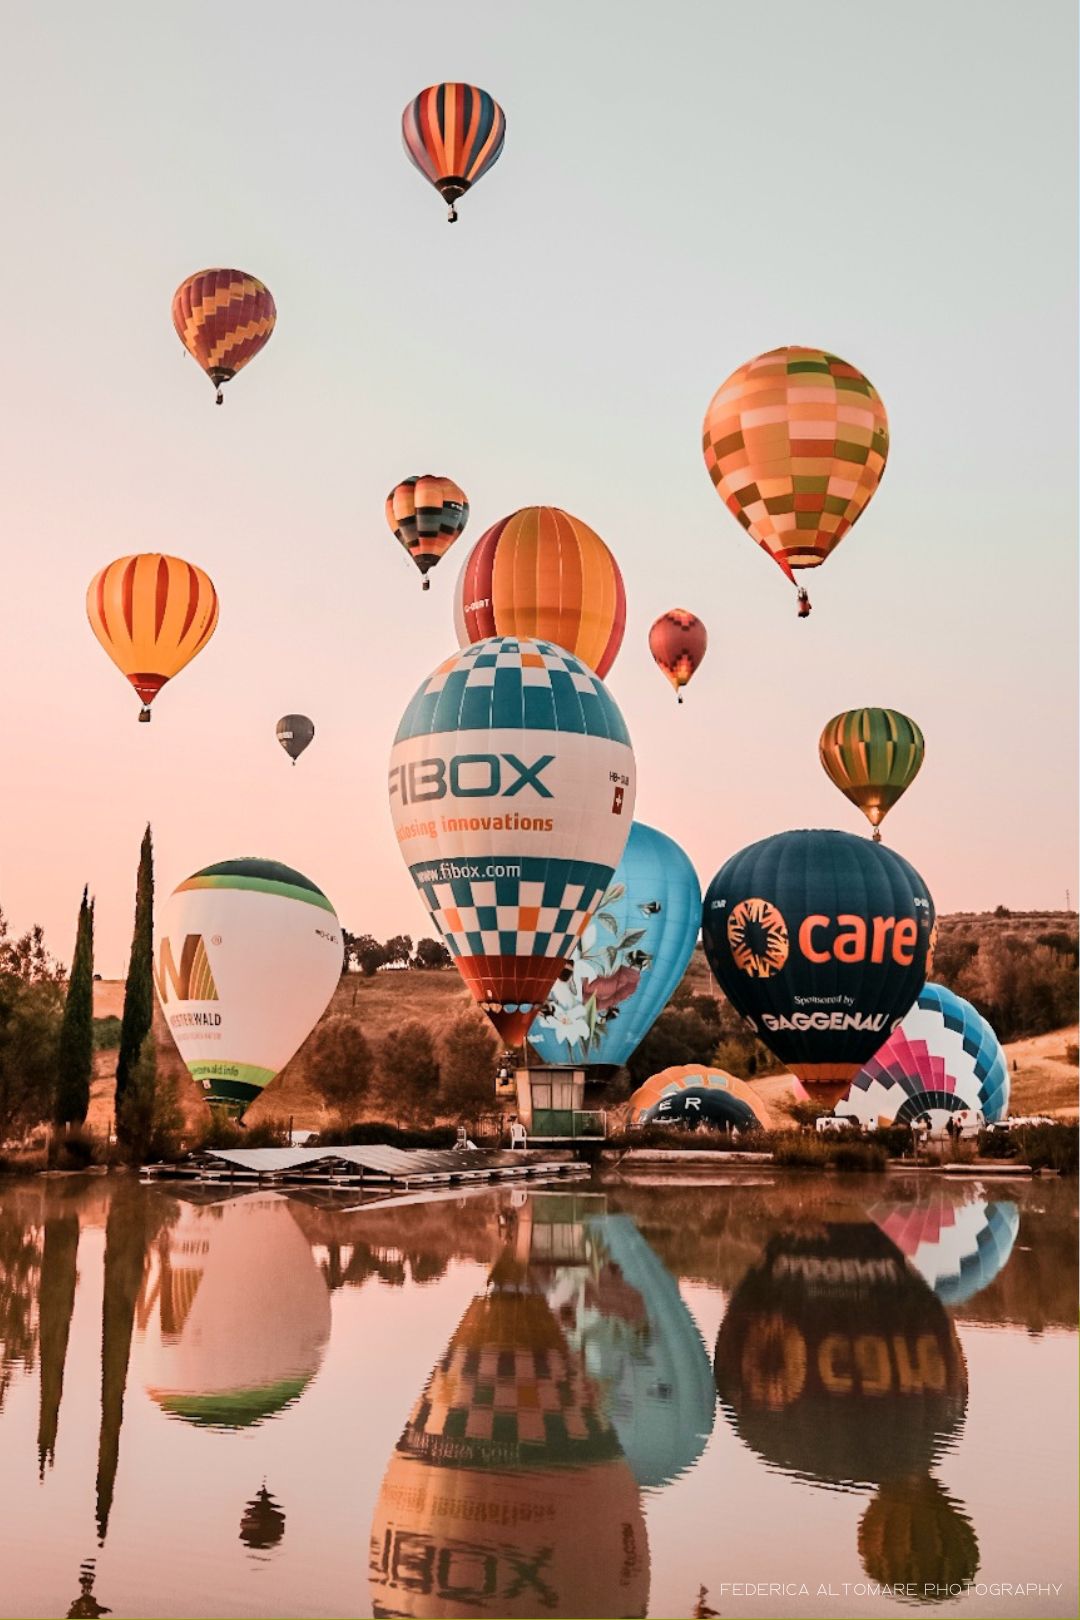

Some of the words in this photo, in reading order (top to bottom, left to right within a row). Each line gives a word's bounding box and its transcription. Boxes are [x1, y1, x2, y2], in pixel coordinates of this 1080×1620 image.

[441, 812, 554, 833] innovations
[416, 861, 521, 882] www.fibox.com
[798, 913, 918, 966] care
[761, 1011, 890, 1032] GAGGENAU
